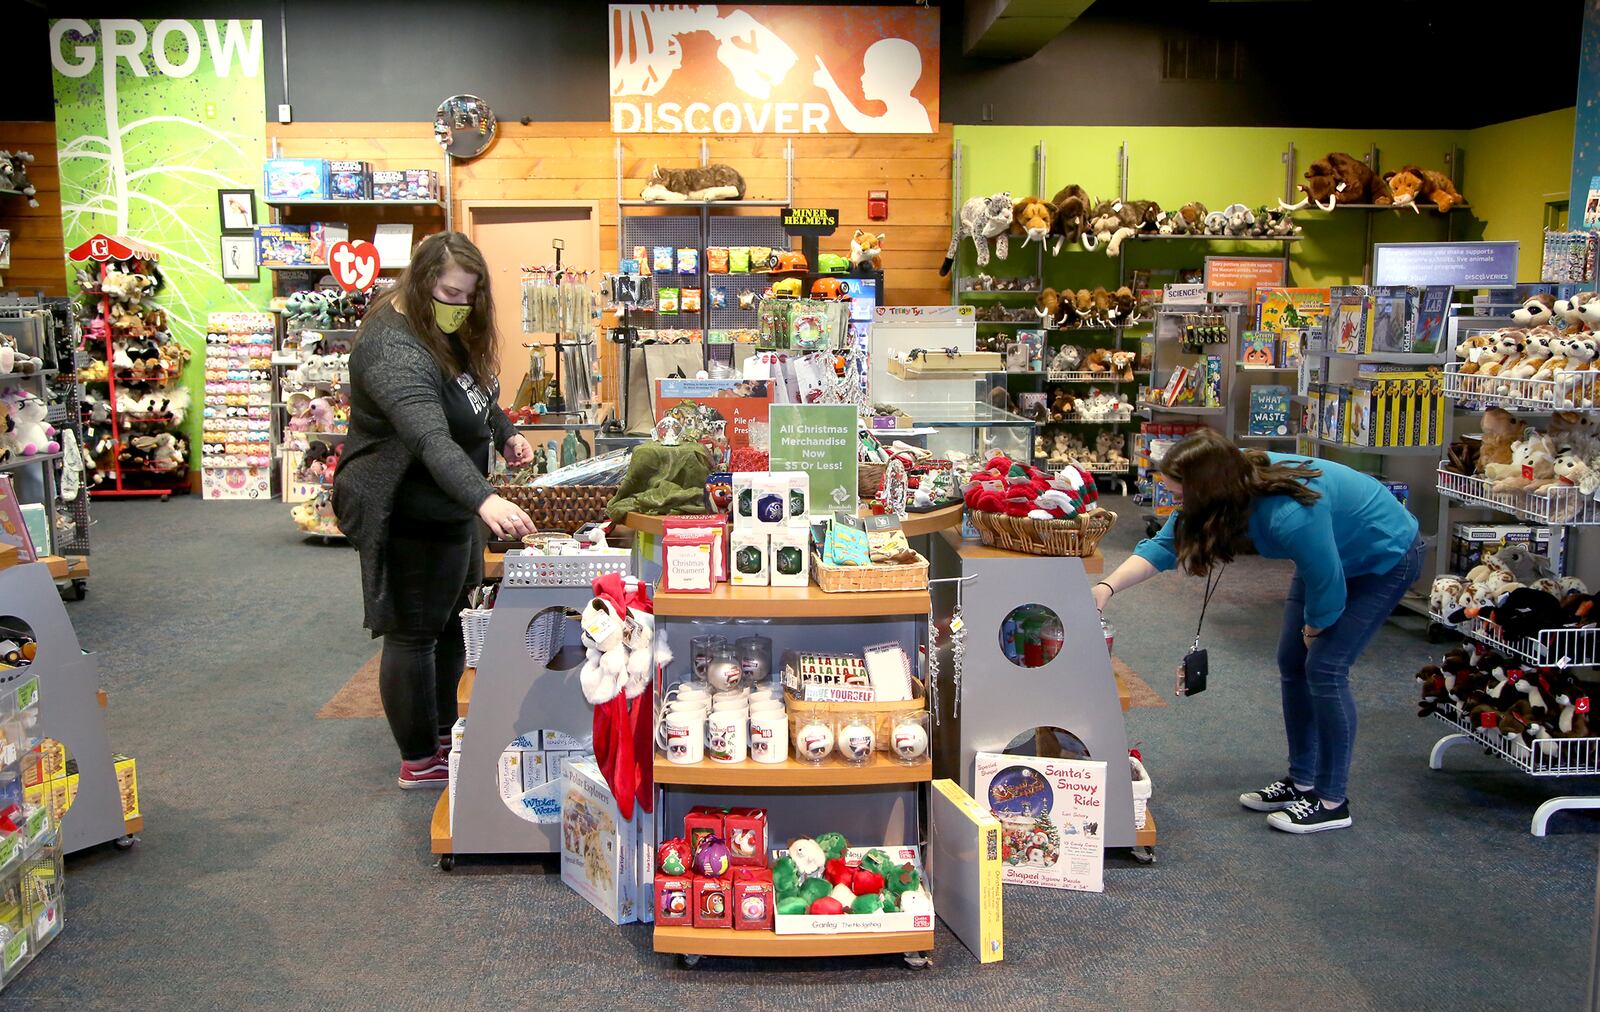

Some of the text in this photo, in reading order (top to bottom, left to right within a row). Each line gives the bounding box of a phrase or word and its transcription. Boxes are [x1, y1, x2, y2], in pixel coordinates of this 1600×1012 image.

[49, 18, 263, 78] GROW
[613, 101, 831, 134] DISCOVER
[792, 208, 828, 218] MINER
[784, 216, 836, 226] HELMETS
[1466, 248, 1494, 256] supports
[333, 244, 375, 290] ty
[1465, 273, 1508, 281] DISCOVERIES
[1168, 288, 1198, 298] SCIENCE!
[1424, 299, 1443, 313] LAB
[1403, 320, 1412, 352] KidzLabs
[1258, 395, 1283, 404] WHAT
[734, 417, 747, 425] Pile
[1254, 413, 1286, 422] WASTE
[780, 424, 848, 434] All Christmas
[781, 436, 847, 446] Merchandise
[802, 450, 826, 458] Now
[785, 461, 843, 470] $5 Or Less!
[802, 656, 865, 668] FA LA LA LA
[803, 665, 867, 677] LA LA LA LA
[803, 674, 840, 684] NOPE
[830, 689, 872, 701] YOURSELF
[1044, 765, 1092, 780] Santa's
[569, 771, 609, 805] Polar Explorers
[1056, 778, 1098, 796] Snowy
[1073, 793, 1100, 807] Ride
[1006, 868, 1039, 880] Shaped
